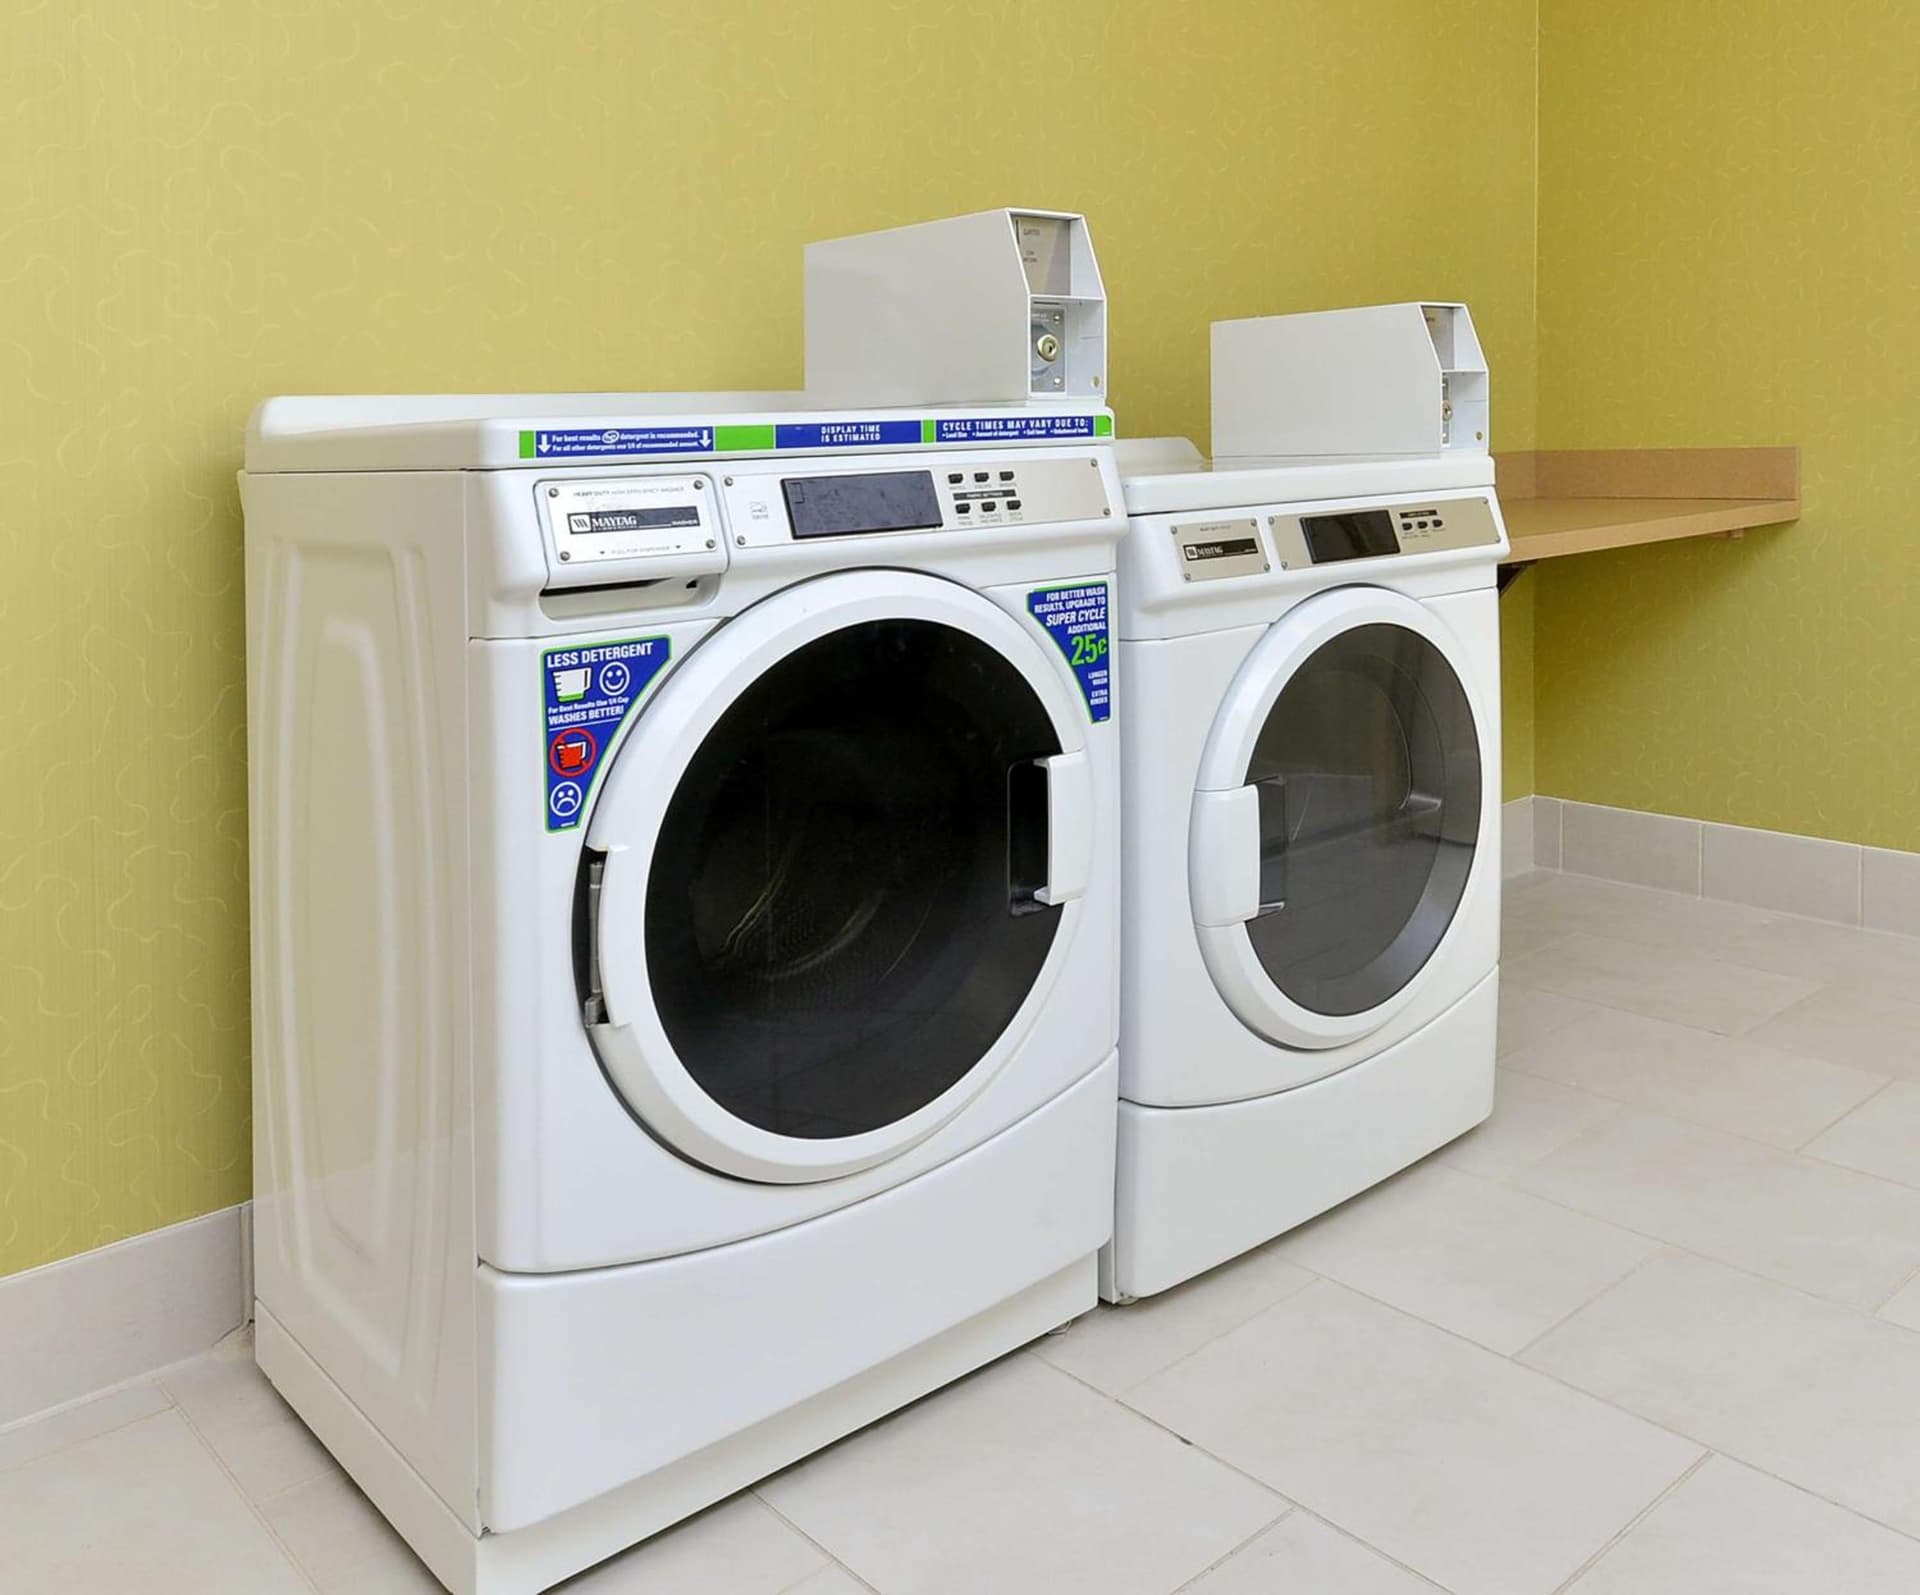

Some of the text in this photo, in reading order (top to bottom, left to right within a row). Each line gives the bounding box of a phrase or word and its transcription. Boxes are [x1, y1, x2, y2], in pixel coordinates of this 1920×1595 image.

[821, 424, 880, 434] DISPLAY TIME
[942, 422, 972, 432] CYCLE
[976, 421, 1004, 430] TIMES
[1007, 420, 1026, 430] MAY
[1029, 420, 1052, 429] VARY
[1055, 418, 1072, 428] DUE
[821, 433, 880, 443] IS ESTIMATED
[592, 515, 637, 528] MAYTAG
[1046, 586, 1105, 602] FOR BETTER WASH
[1066, 598, 1096, 610] UPGRADE
[1097, 596, 1106, 605] TO
[1046, 607, 1106, 627] SUPER CYCLE
[1067, 621, 1106, 634] ADDITIONAL
[547, 642, 653, 668] LESS DETERGENT
[548, 711, 587, 725] WASHES
